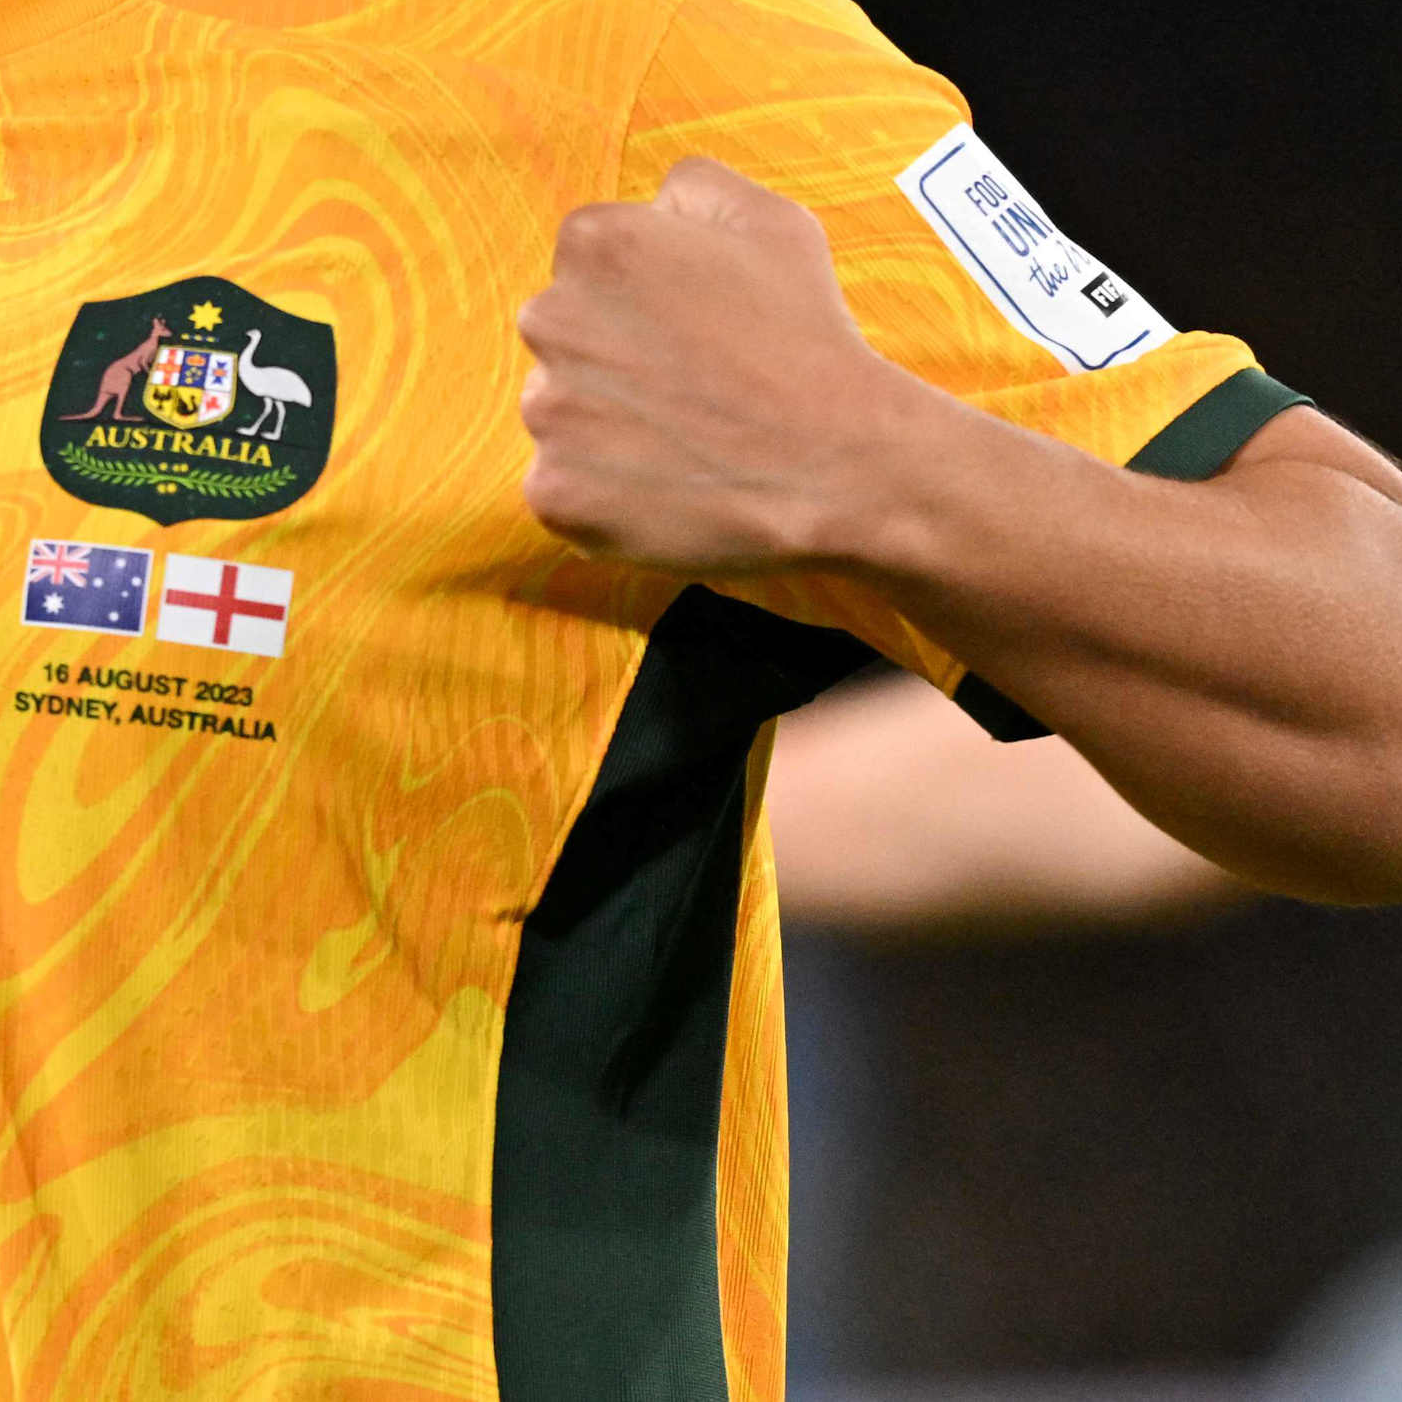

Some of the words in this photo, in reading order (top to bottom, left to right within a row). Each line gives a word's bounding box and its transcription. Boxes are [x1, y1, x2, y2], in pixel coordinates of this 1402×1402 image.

[965, 174, 1008, 216] FOO
[992, 200, 1055, 257] UNI
[85, 425, 272, 467] AUSTRALIA
[44, 663, 69, 684] 16
[78, 666, 187, 697] AUGUST
[194, 681, 254, 707] 2023
[15, 692, 122, 725] SYDNEY,
[129, 704, 277, 742] AUSTRALIA
